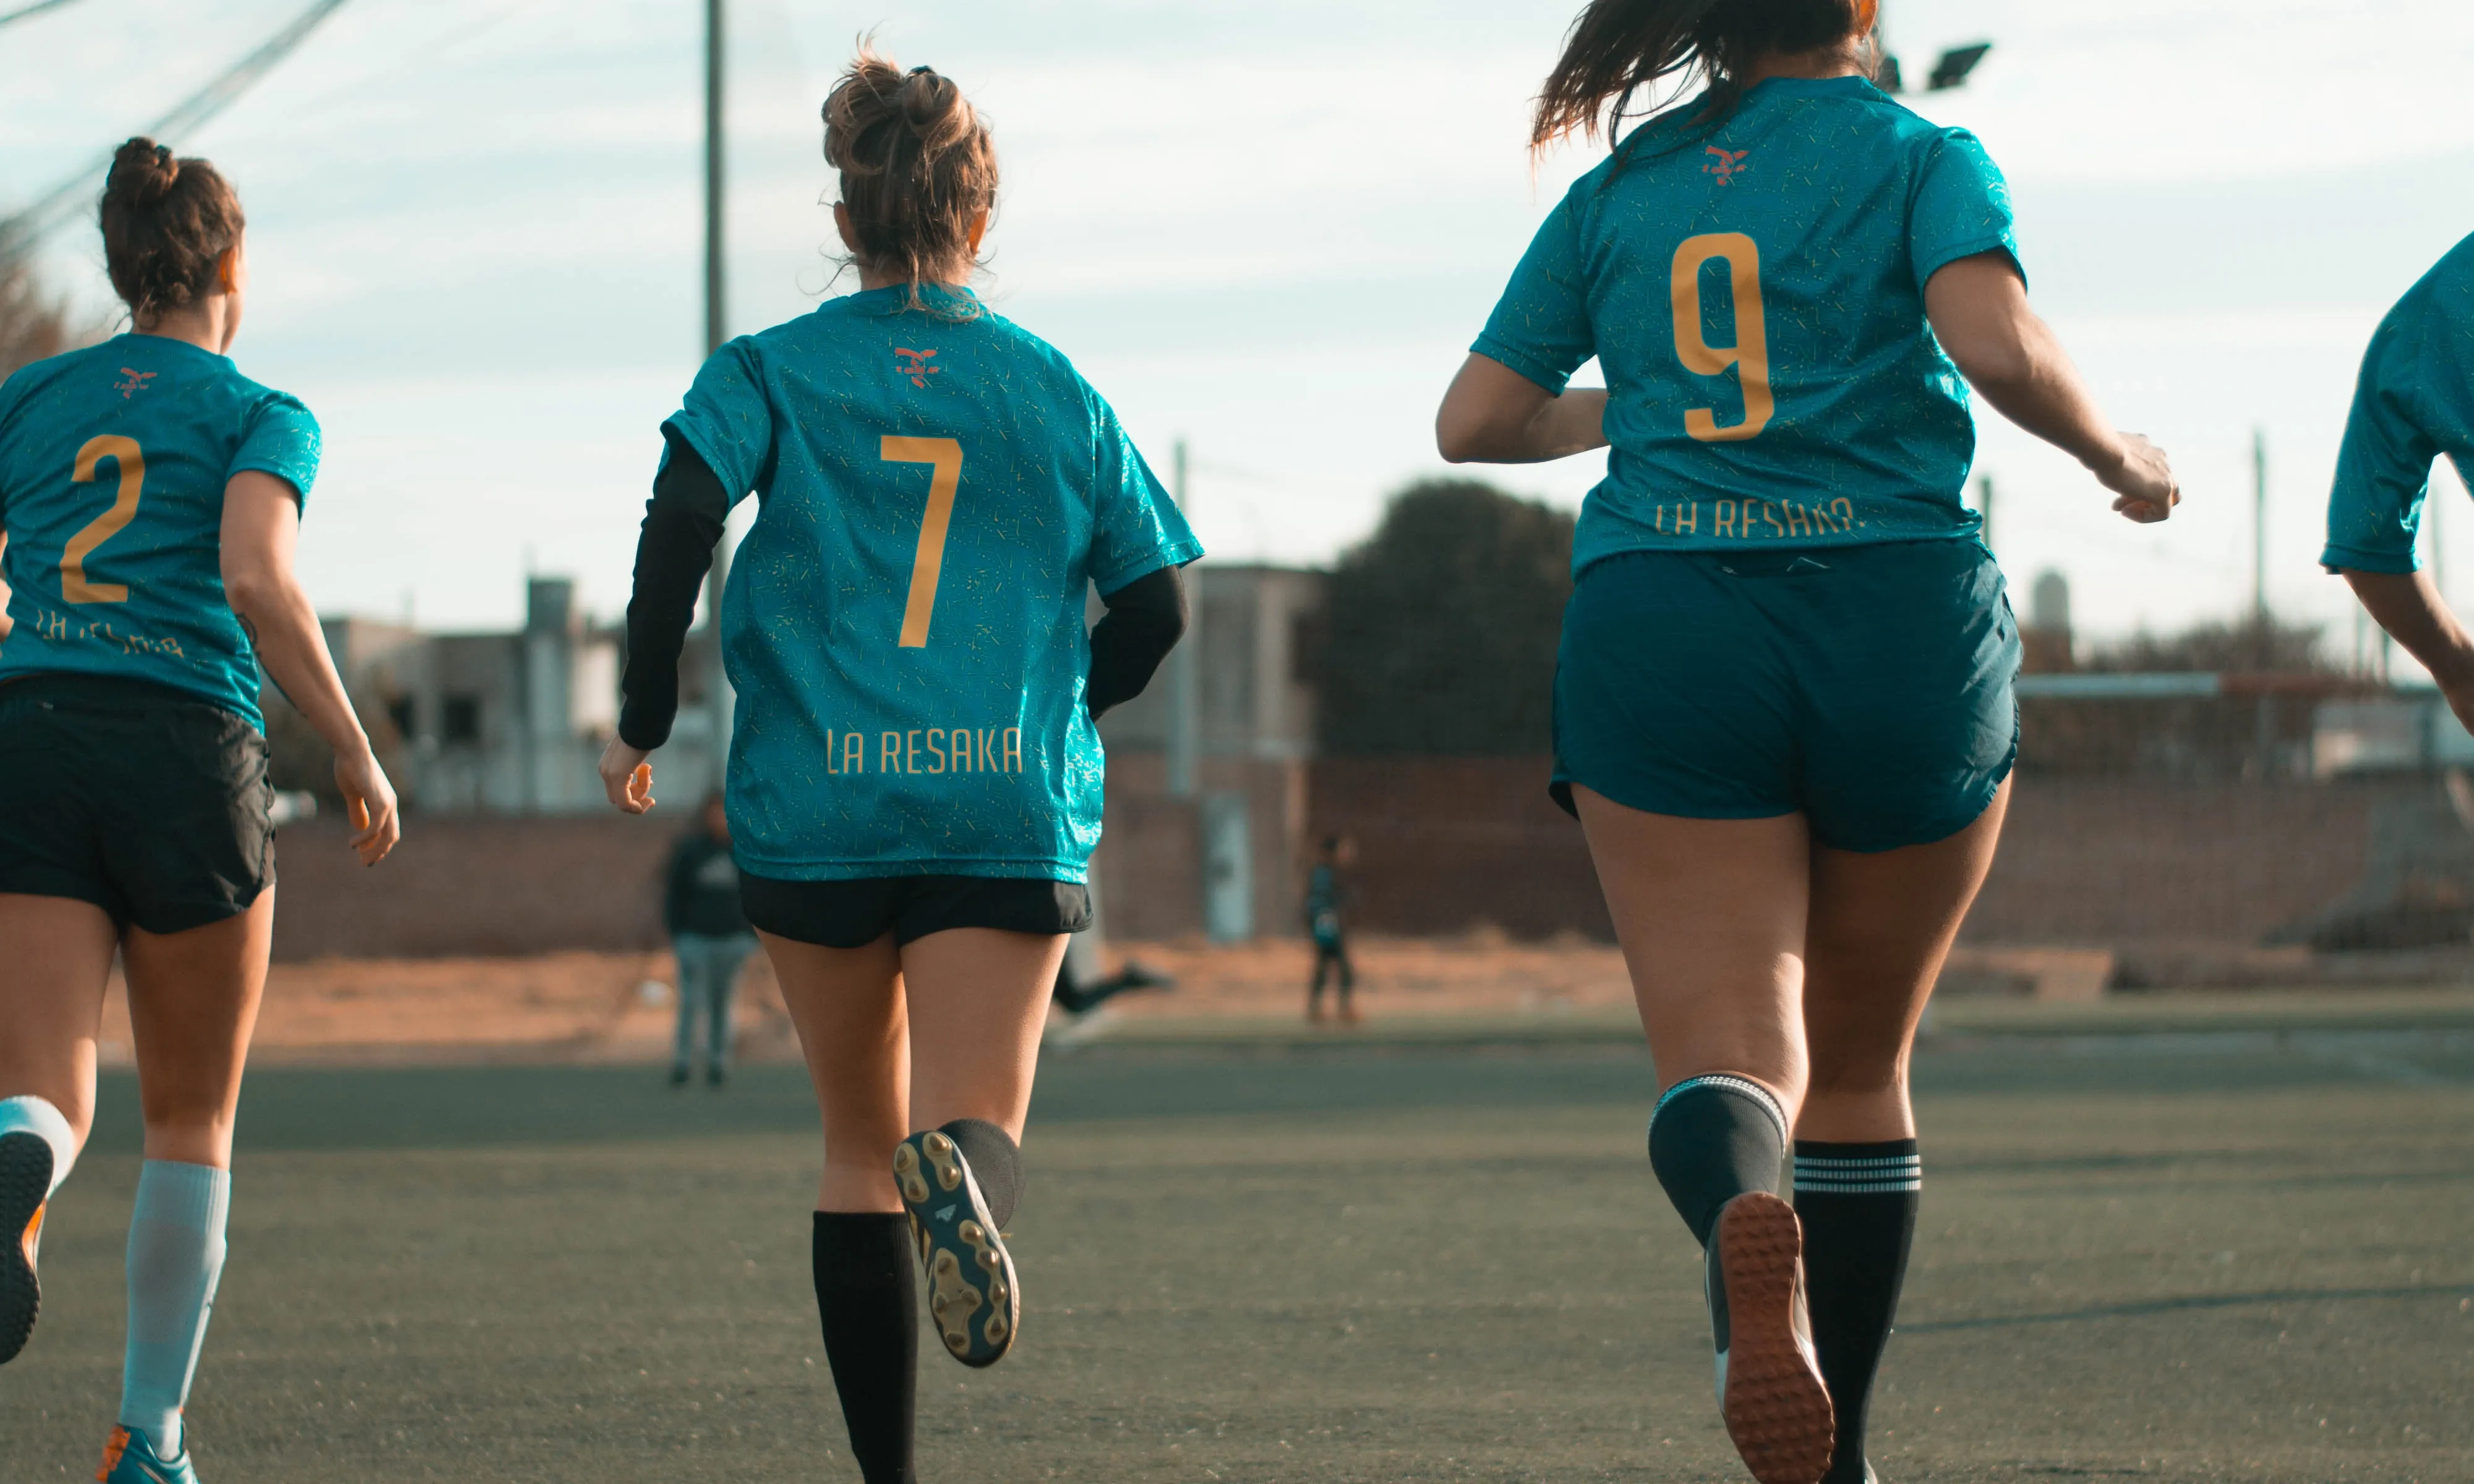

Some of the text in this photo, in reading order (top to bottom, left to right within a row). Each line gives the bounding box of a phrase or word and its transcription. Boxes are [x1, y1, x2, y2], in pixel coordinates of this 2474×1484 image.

[1671, 232, 1774, 441] 9
[60, 435, 145, 603] 2
[881, 435, 964, 648] 7
[828, 727, 1022, 774] LA RESAKA
